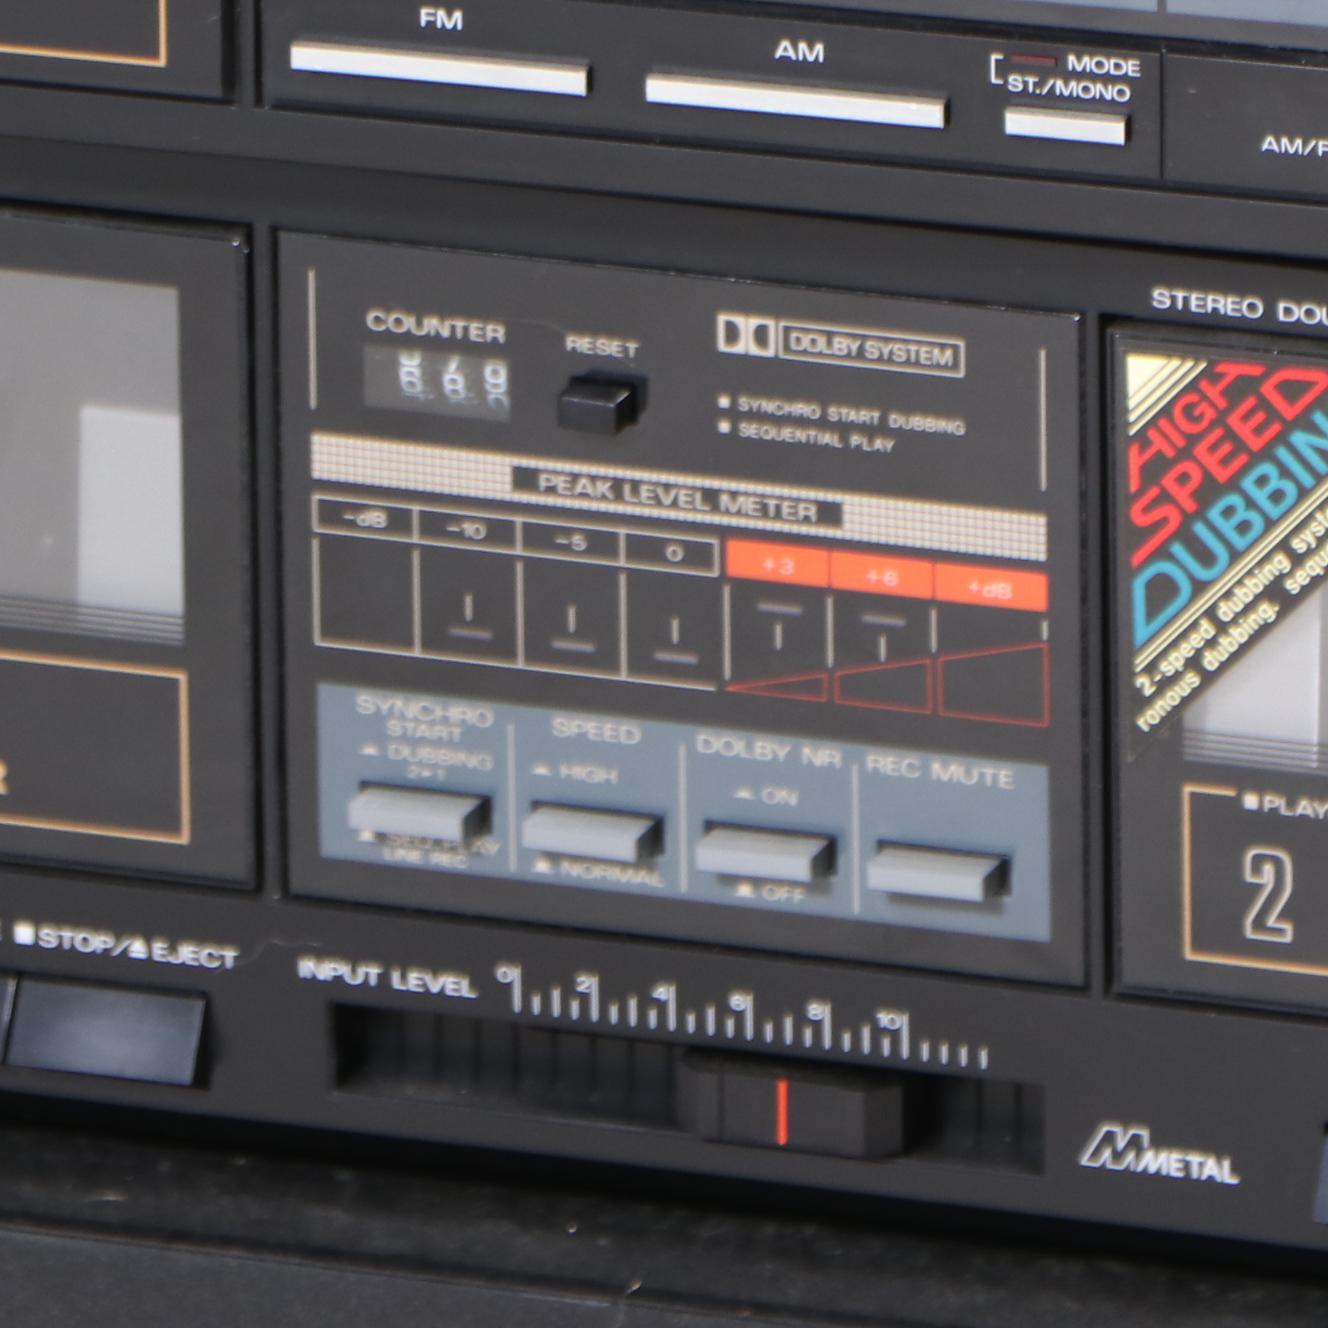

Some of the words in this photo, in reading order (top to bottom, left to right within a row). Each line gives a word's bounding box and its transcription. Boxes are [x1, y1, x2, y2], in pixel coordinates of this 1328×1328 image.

[420, 7, 462, 31] FM
[774, 40, 824, 63] AM
[1067, 55, 1141, 77] MODE
[1007, 75, 1131, 102] ST./MONO
[1152, 289, 1263, 320] STEREO
[366, 309, 506, 345] COUNTER
[566, 334, 640, 360] RESET
[790, 333, 861, 358] DOLBY
[864, 340, 954, 368] SYSTEM
[1127, 361, 1265, 493] HIGH
[538, 473, 613, 502] PEAK
[624, 482, 712, 512] LEVEL
[719, 492, 818, 523] METER
[1135, 622, 1215, 697] 2-speed
[1217, 554, 1292, 624] dubbing
[1136, 671, 1201, 734] ronous
[696, 735, 791, 762] DOLBY
[802, 747, 842, 769] NR
[867, 755, 920, 779] REC
[932, 761, 1015, 791] MUTE
[1245, 845, 1294, 943] 2
[298, 955, 384, 987] INPUT
[390, 966, 478, 999] LEVEL
